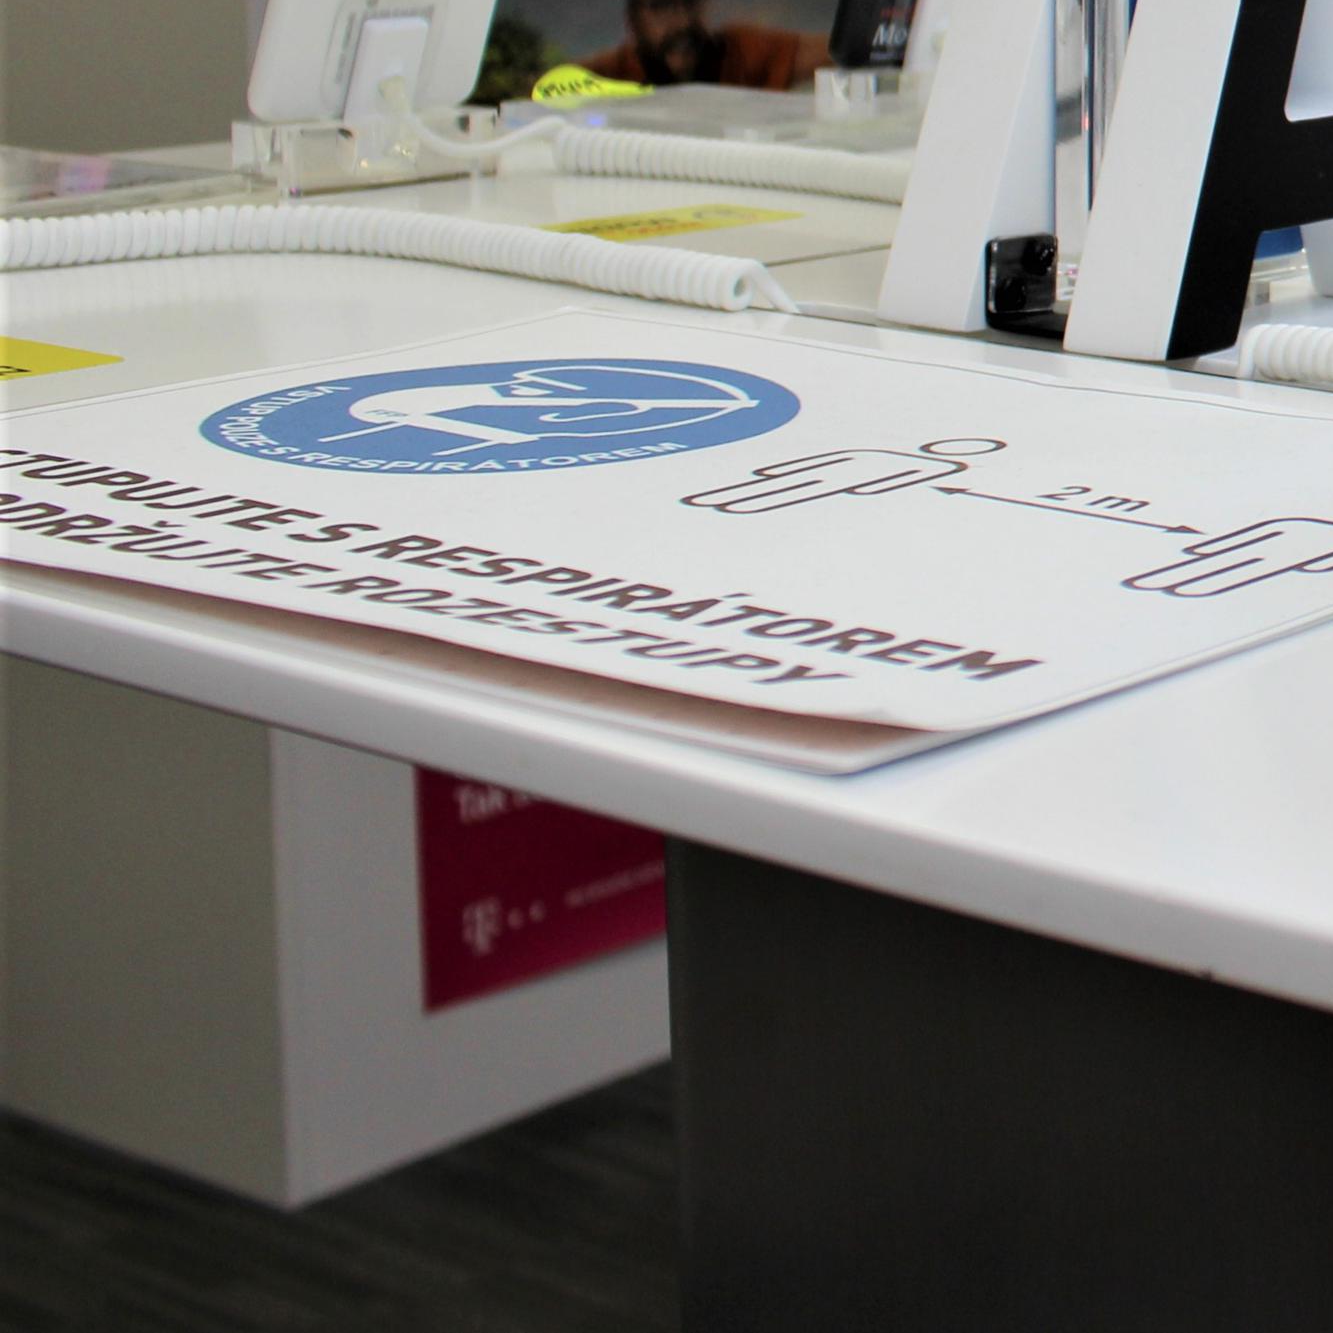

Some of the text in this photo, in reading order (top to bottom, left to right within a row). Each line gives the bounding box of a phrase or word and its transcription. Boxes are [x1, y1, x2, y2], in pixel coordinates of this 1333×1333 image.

[219, 385, 689, 472] VSTUP POUZE S RESPIRÁTOREM
[1035, 485, 1150, 512] 2 m
[286, 522, 381, 543] S
[347, 534, 1046, 682] RESPIRÁTOREM
[298, 574, 856, 685] ROZESTUPY
